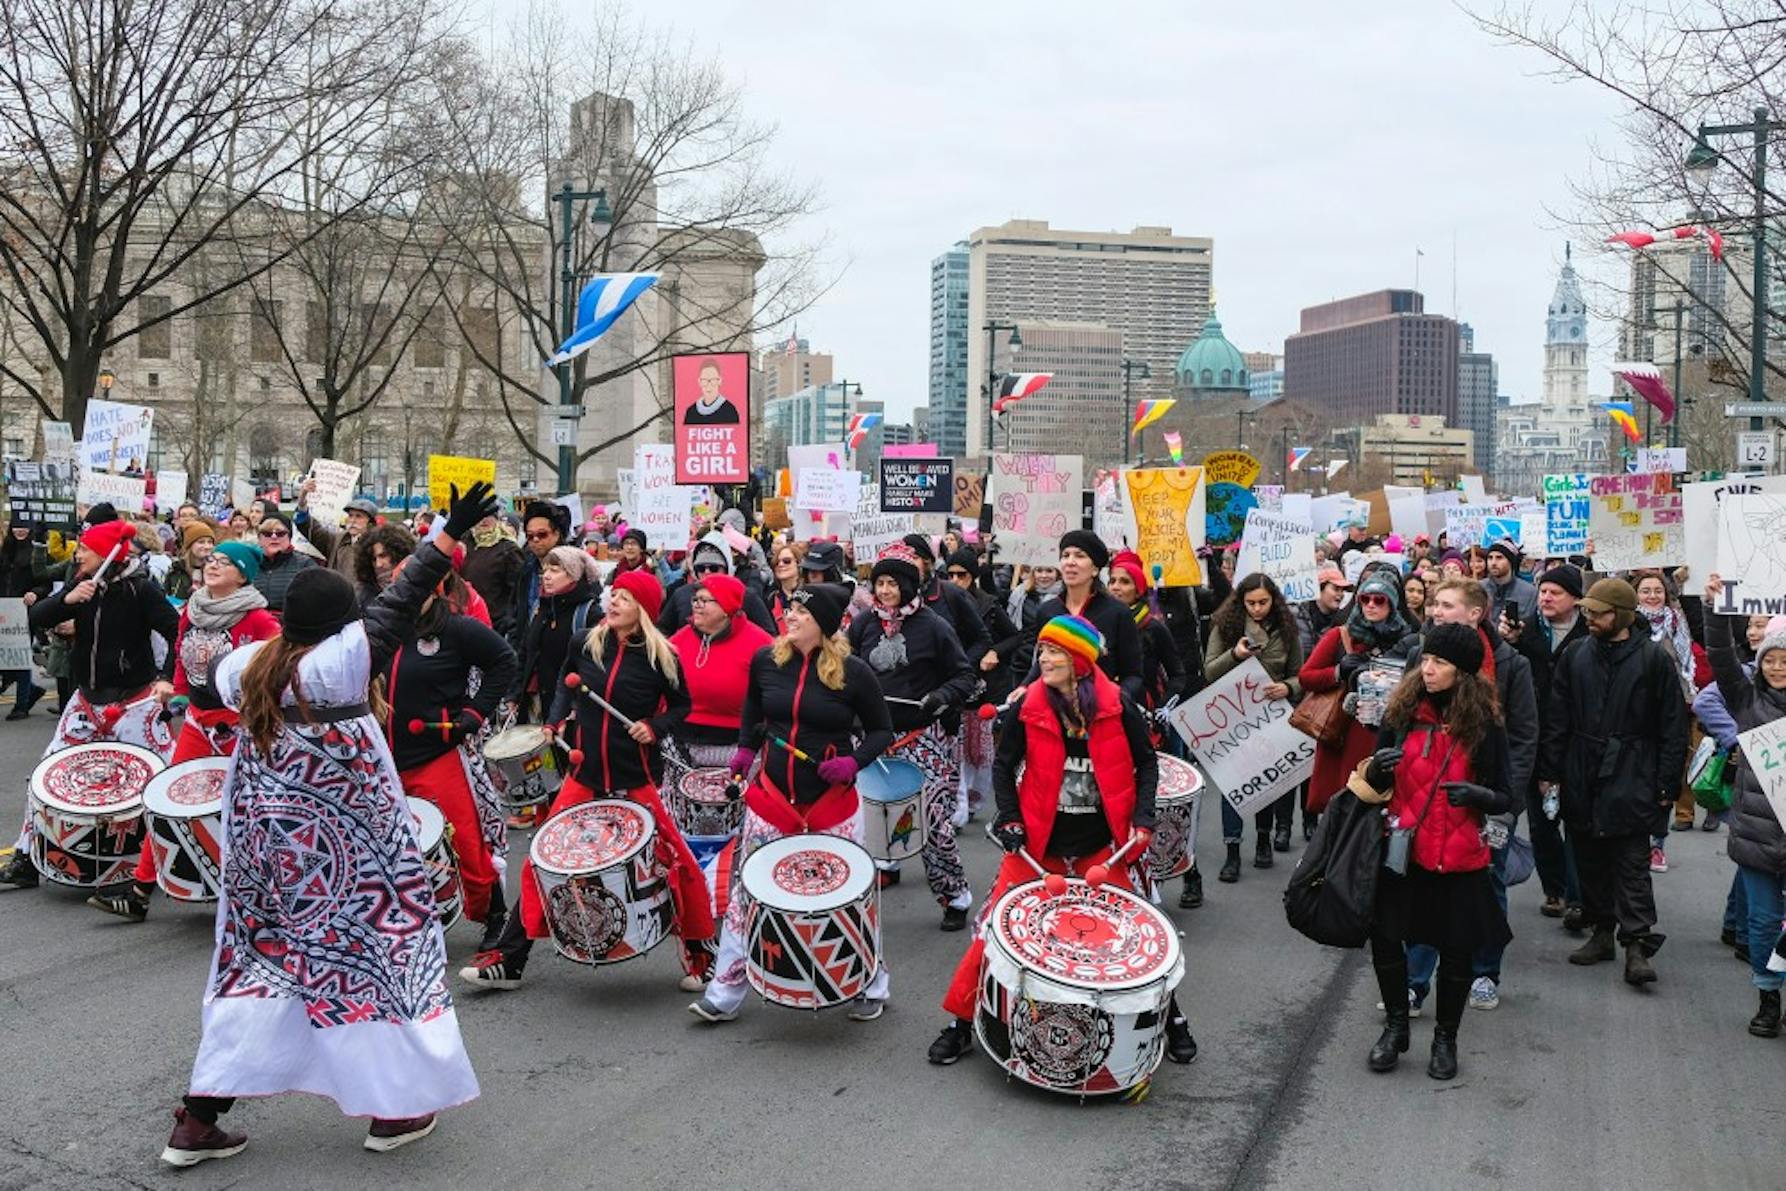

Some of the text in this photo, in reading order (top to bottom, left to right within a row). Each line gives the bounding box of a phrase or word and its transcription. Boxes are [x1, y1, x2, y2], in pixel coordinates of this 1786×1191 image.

[90, 407, 124, 428] HATE
[86, 428, 113, 445] DOES
[117, 420, 141, 437] NOT
[688, 428, 735, 440] FIGHT
[688, 442, 737, 455] LIKE A
[685, 456, 740, 475] GIRL
[885, 464, 907, 475] WELL
[995, 455, 1056, 475] WHEN
[1208, 453, 1255, 468] WOMEN
[885, 474, 938, 489] WOMEN
[1544, 474, 1575, 492] Girls
[886, 497, 926, 508] HISTORY
[998, 492, 1029, 514] GO
[1136, 490, 1169, 506] KEEP
[641, 512, 682, 525] WOMEN
[1547, 501, 1590, 520] FUN
[995, 513, 1028, 534] WE
[1148, 550, 1177, 562] BODY
[1260, 543, 1293, 563] BUILD
[1284, 578, 1316, 601] ALLS
[1178, 673, 1268, 749] LOVE
[1203, 699, 1287, 764] KNOWS
[1229, 742, 1316, 807] BORDERS
